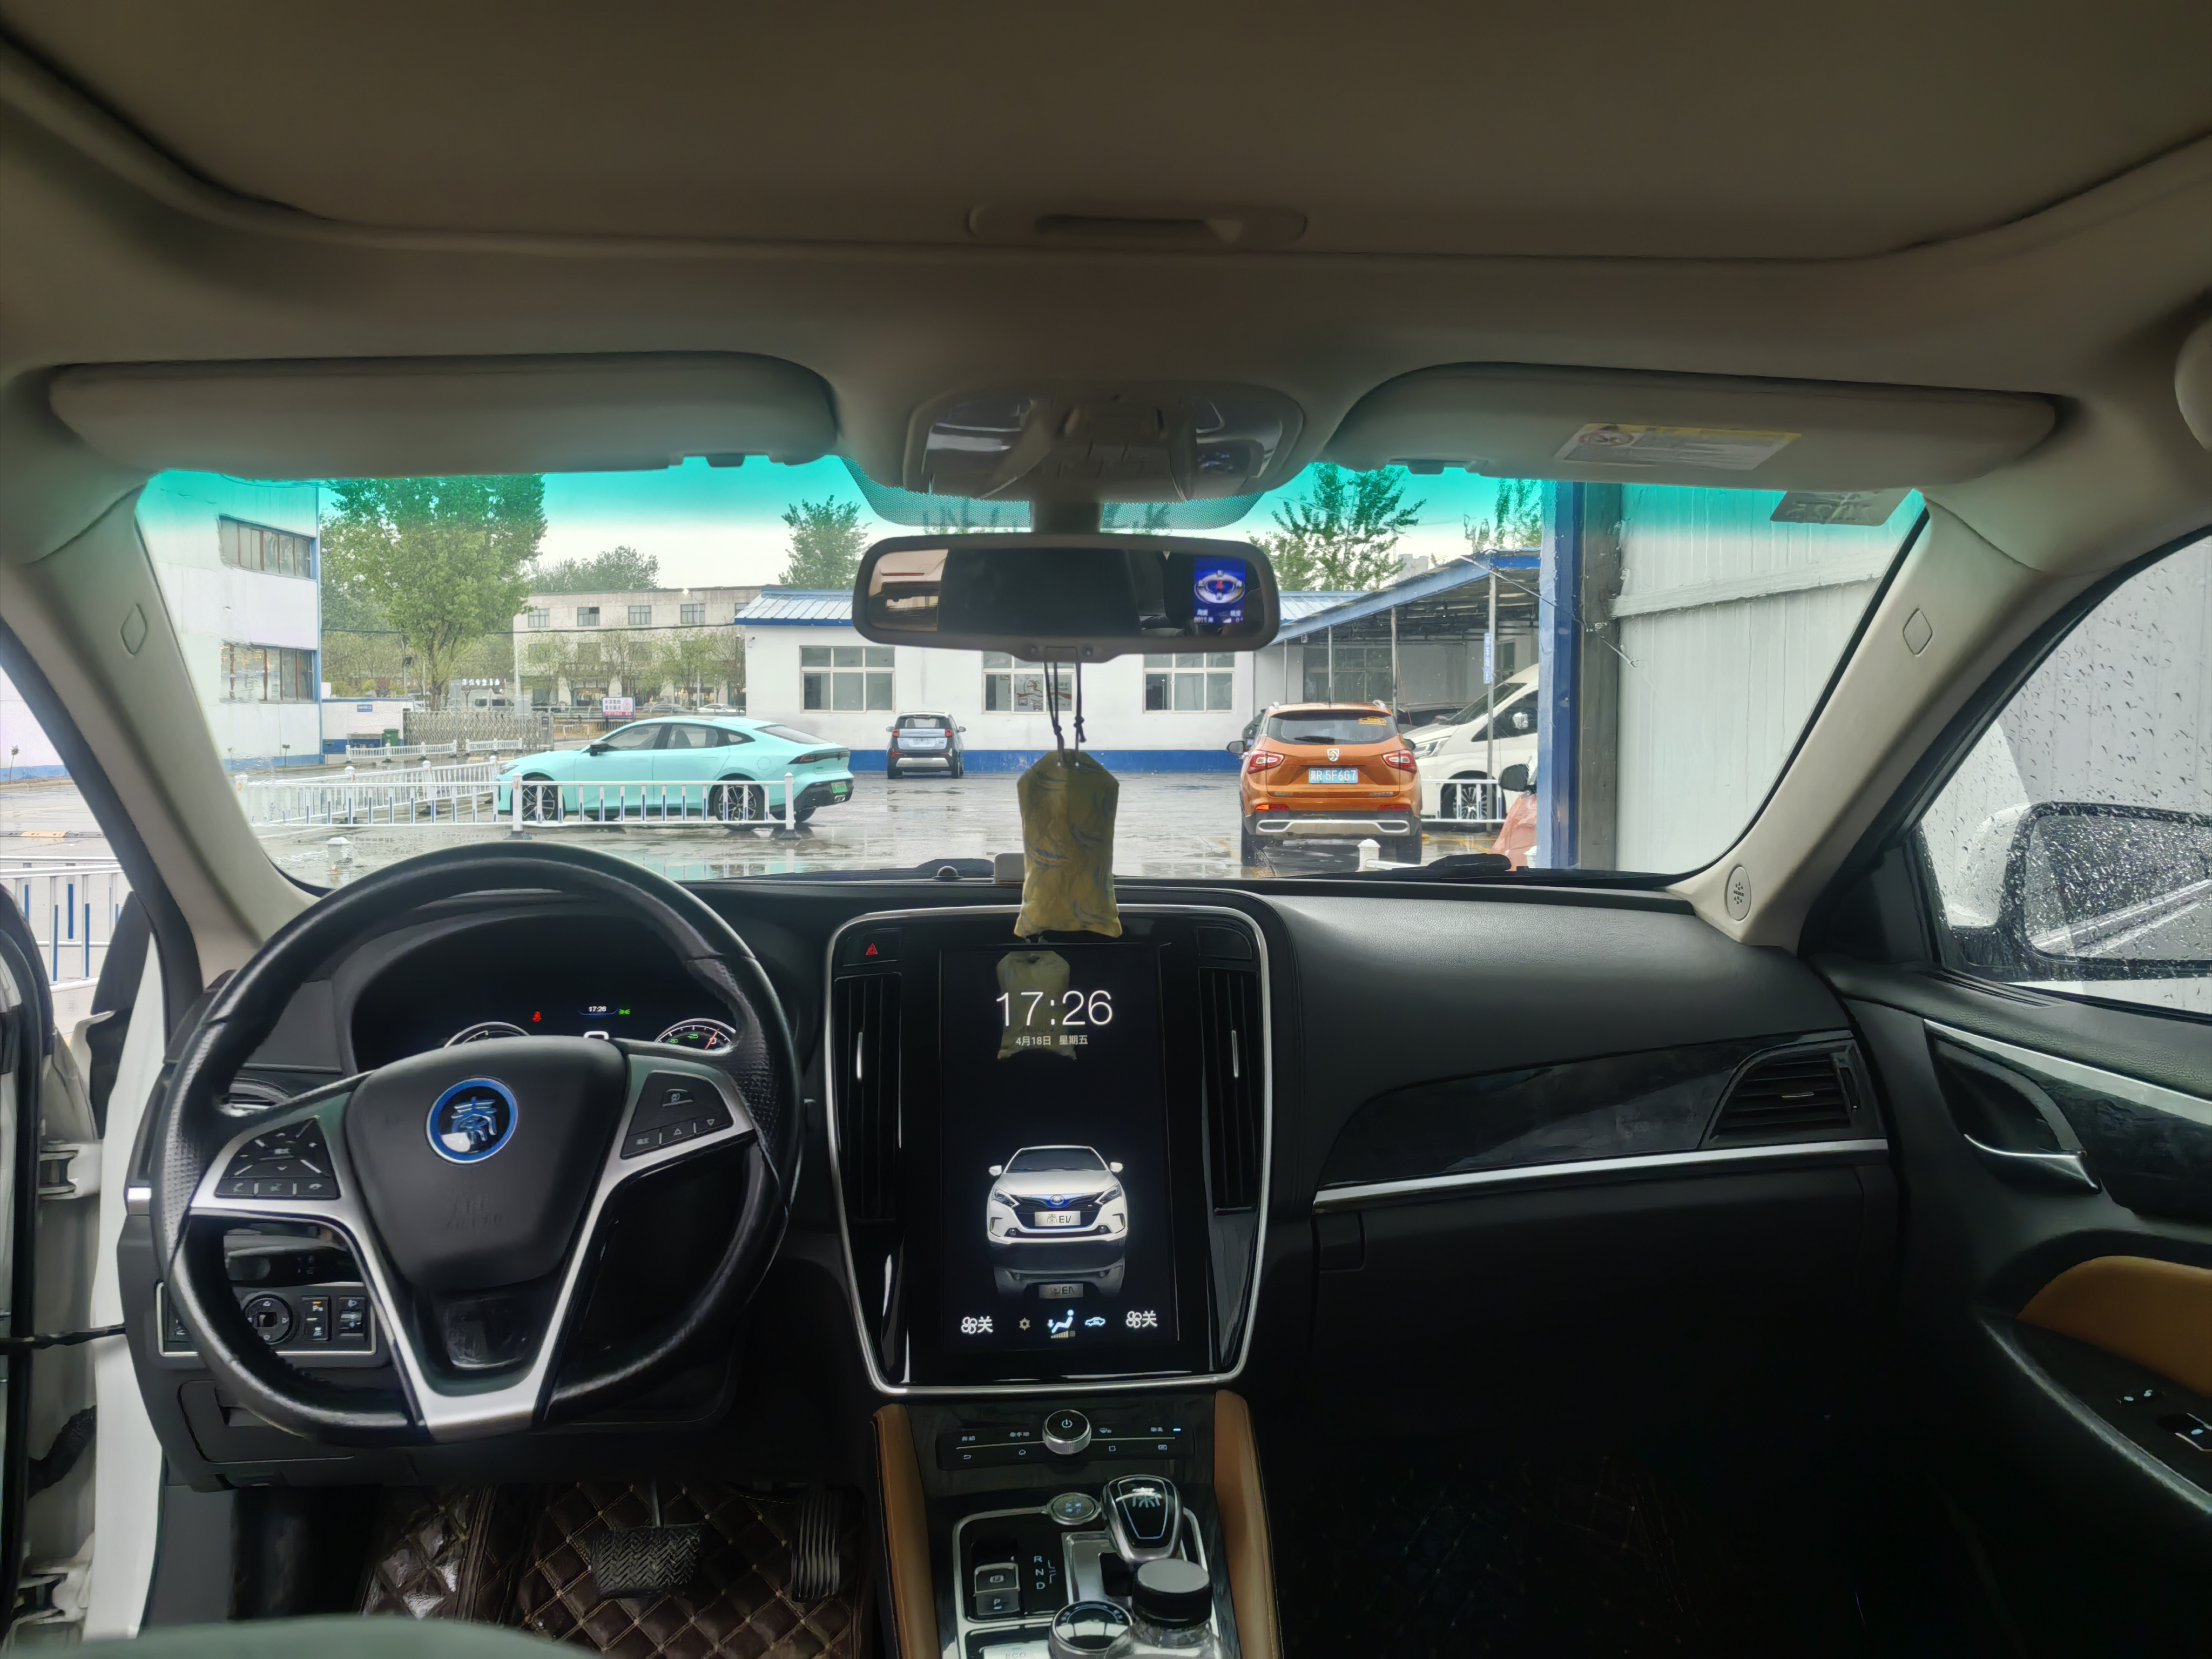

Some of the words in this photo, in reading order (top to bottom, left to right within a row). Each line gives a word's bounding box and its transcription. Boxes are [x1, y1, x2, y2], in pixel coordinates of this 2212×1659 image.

[996, 990, 1113, 1027] 17:26
[1015, 1035, 1051, 1046] 4月18日
[1059, 1035, 1089, 1046] 星期五
[1142, 1310, 1158, 1328] 关
[977, 1316, 993, 1334] 关
[1034, 1555, 1043, 1563] R
[1035, 1568, 1044, 1576] N
[1036, 1582, 1046, 1590] D
